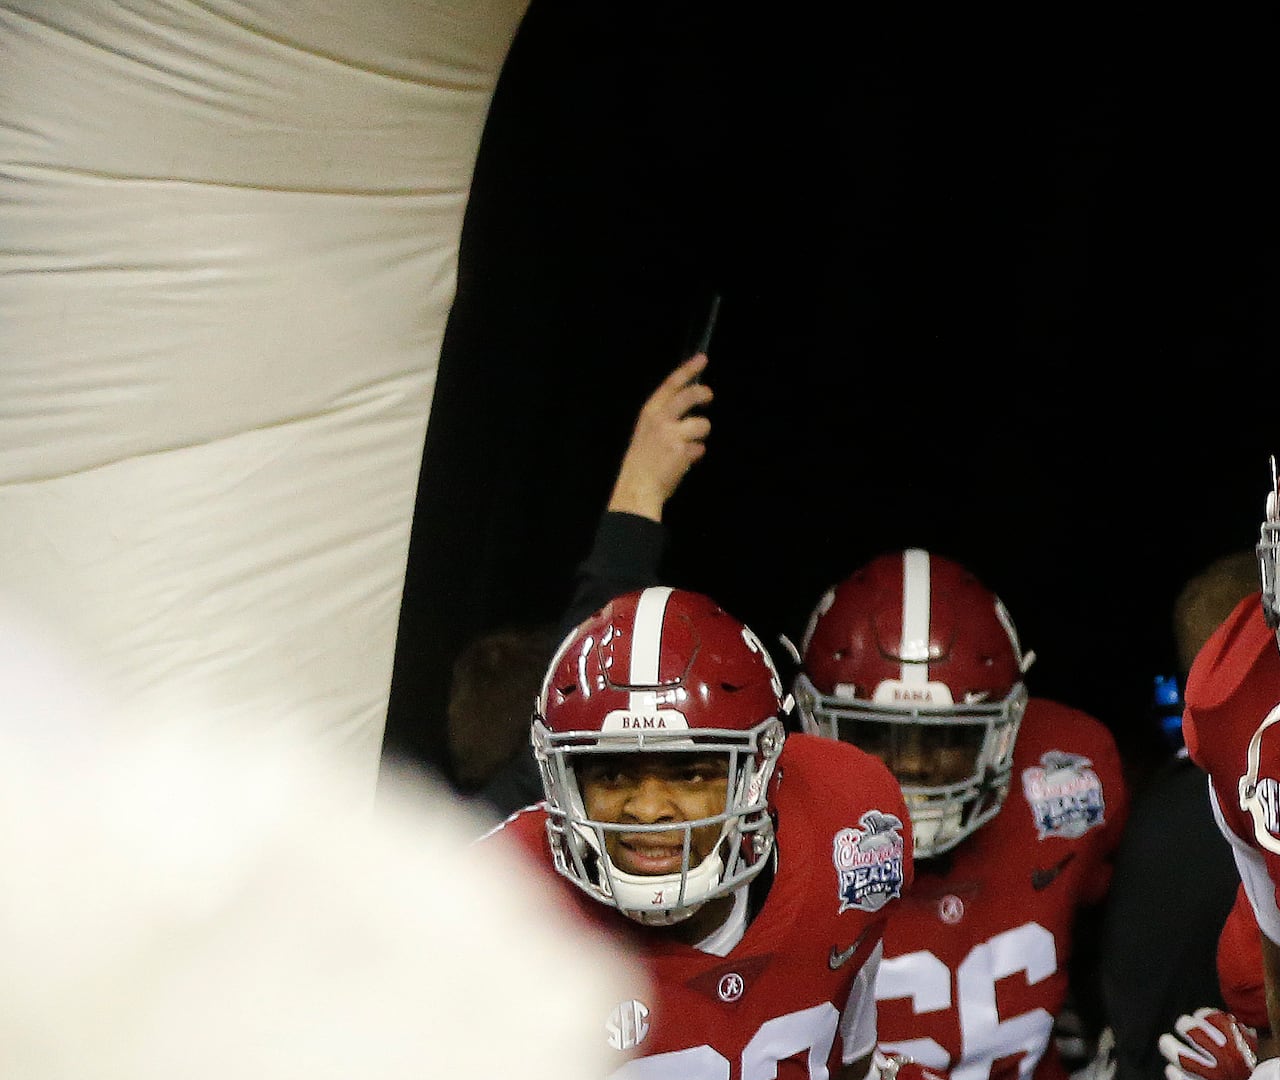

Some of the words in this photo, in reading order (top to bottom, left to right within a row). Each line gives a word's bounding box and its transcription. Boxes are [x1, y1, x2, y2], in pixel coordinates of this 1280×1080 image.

[622, 715, 668, 729] BAMA
[842, 858, 900, 895] PEACH
[605, 999, 650, 1051] SEC
